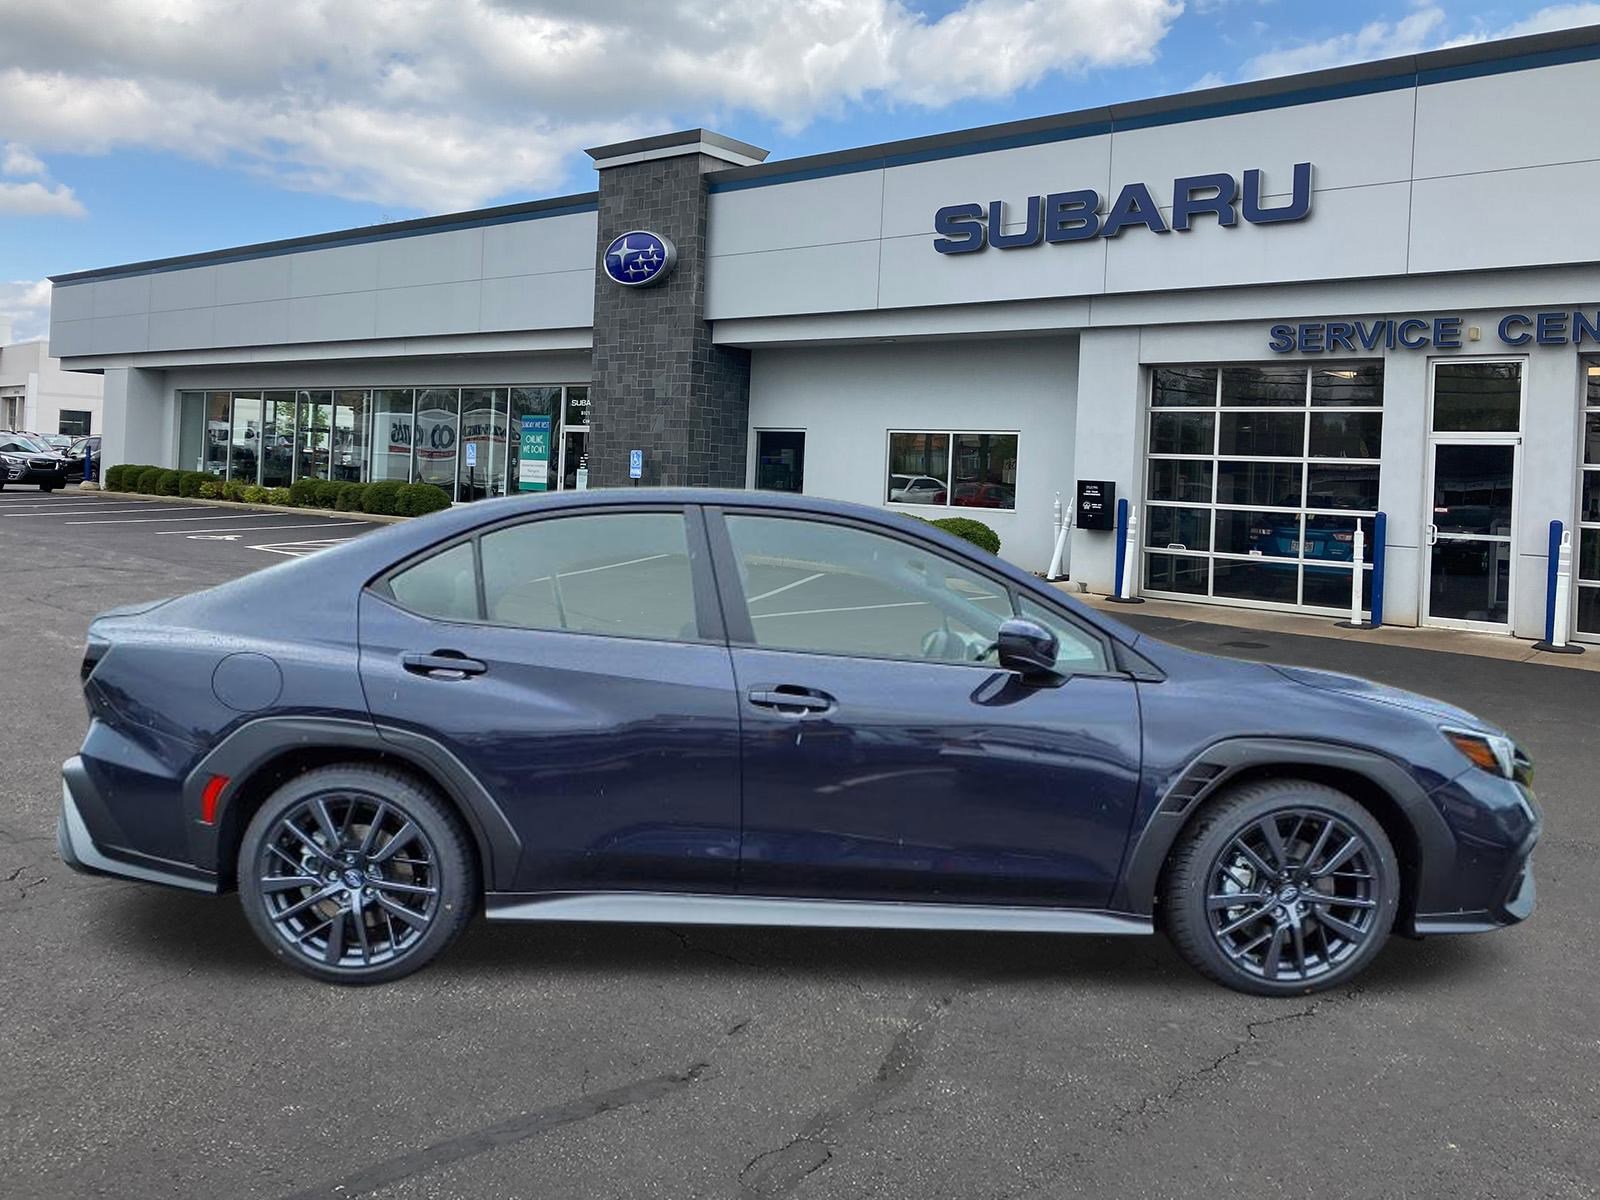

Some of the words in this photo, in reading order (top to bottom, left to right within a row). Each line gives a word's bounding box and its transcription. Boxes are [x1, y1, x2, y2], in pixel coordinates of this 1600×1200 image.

[933, 162, 1313, 254] SUBARU
[1269, 317, 1464, 353] SERVICE
[1498, 311, 1600, 347] CEN
[571, 399, 592, 407] SUBA
